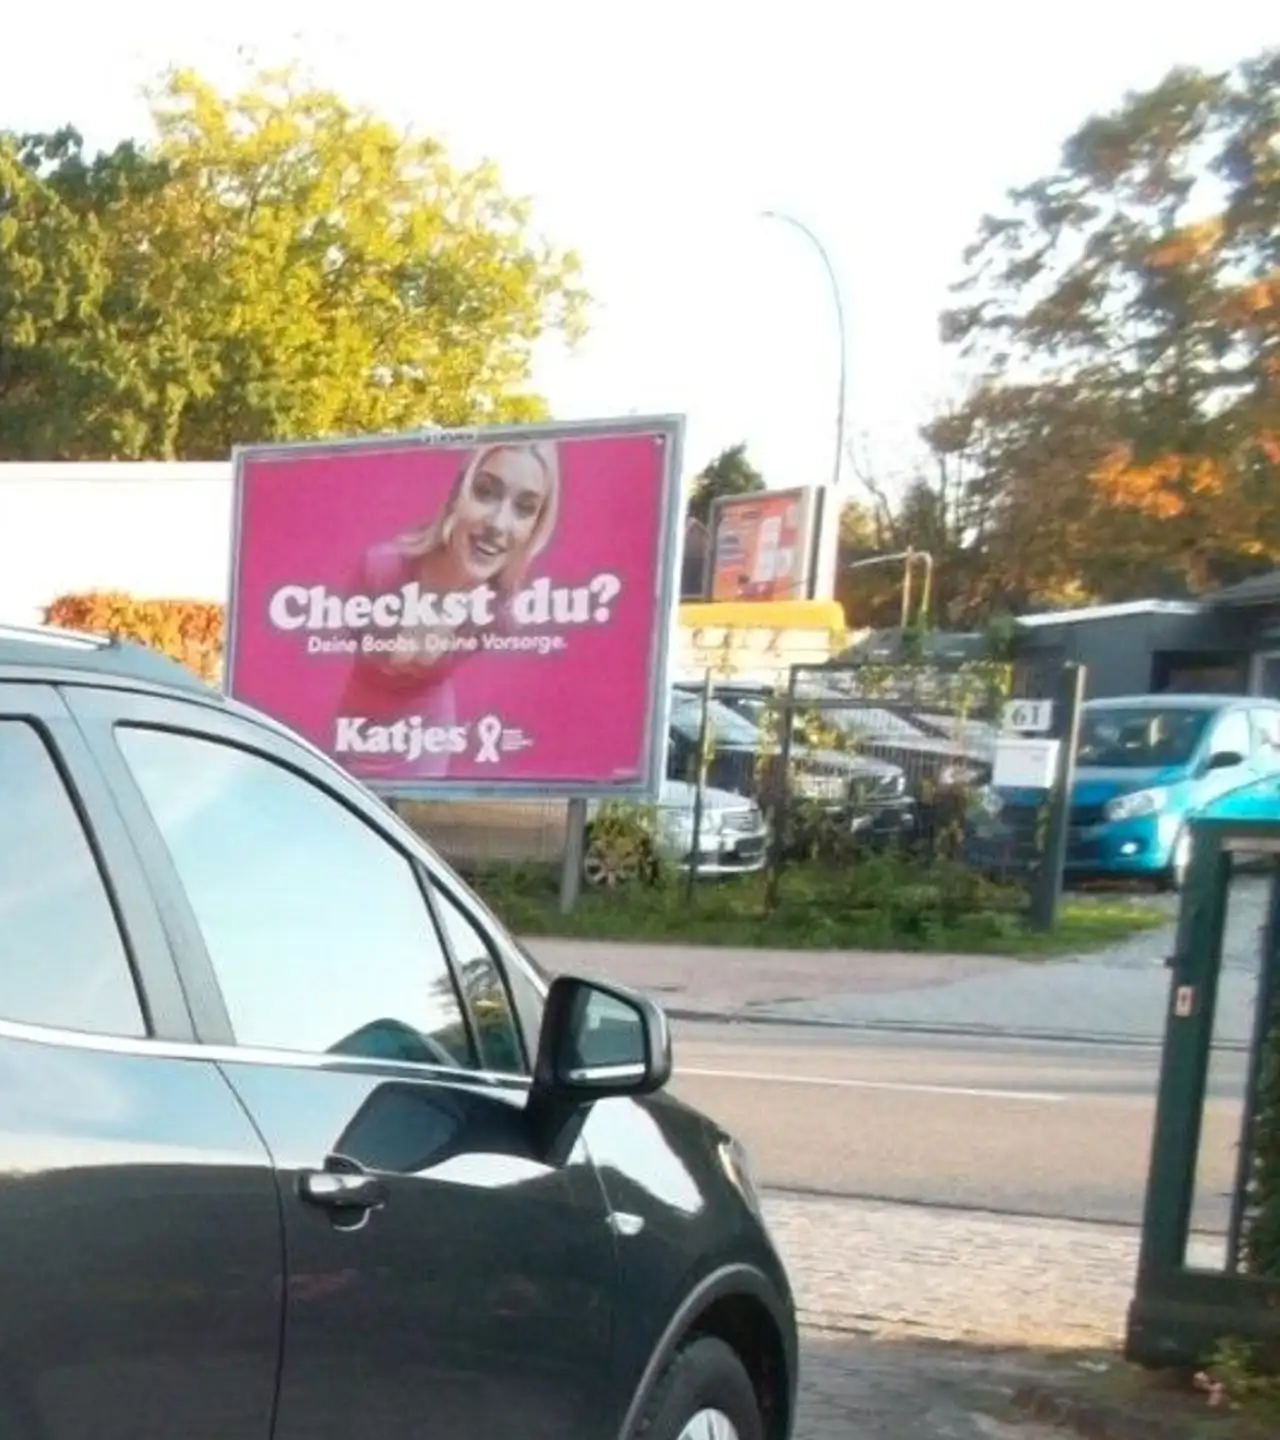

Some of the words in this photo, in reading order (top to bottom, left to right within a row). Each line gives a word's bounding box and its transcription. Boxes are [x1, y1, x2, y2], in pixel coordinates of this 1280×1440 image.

[269, 581, 497, 630] Checkst
[512, 573, 621, 624] du?
[307, 635, 358, 654] Deine
[424, 632, 478, 653] Deine
[482, 632, 568, 655] Vorsorge.
[335, 715, 468, 762] Katjes
